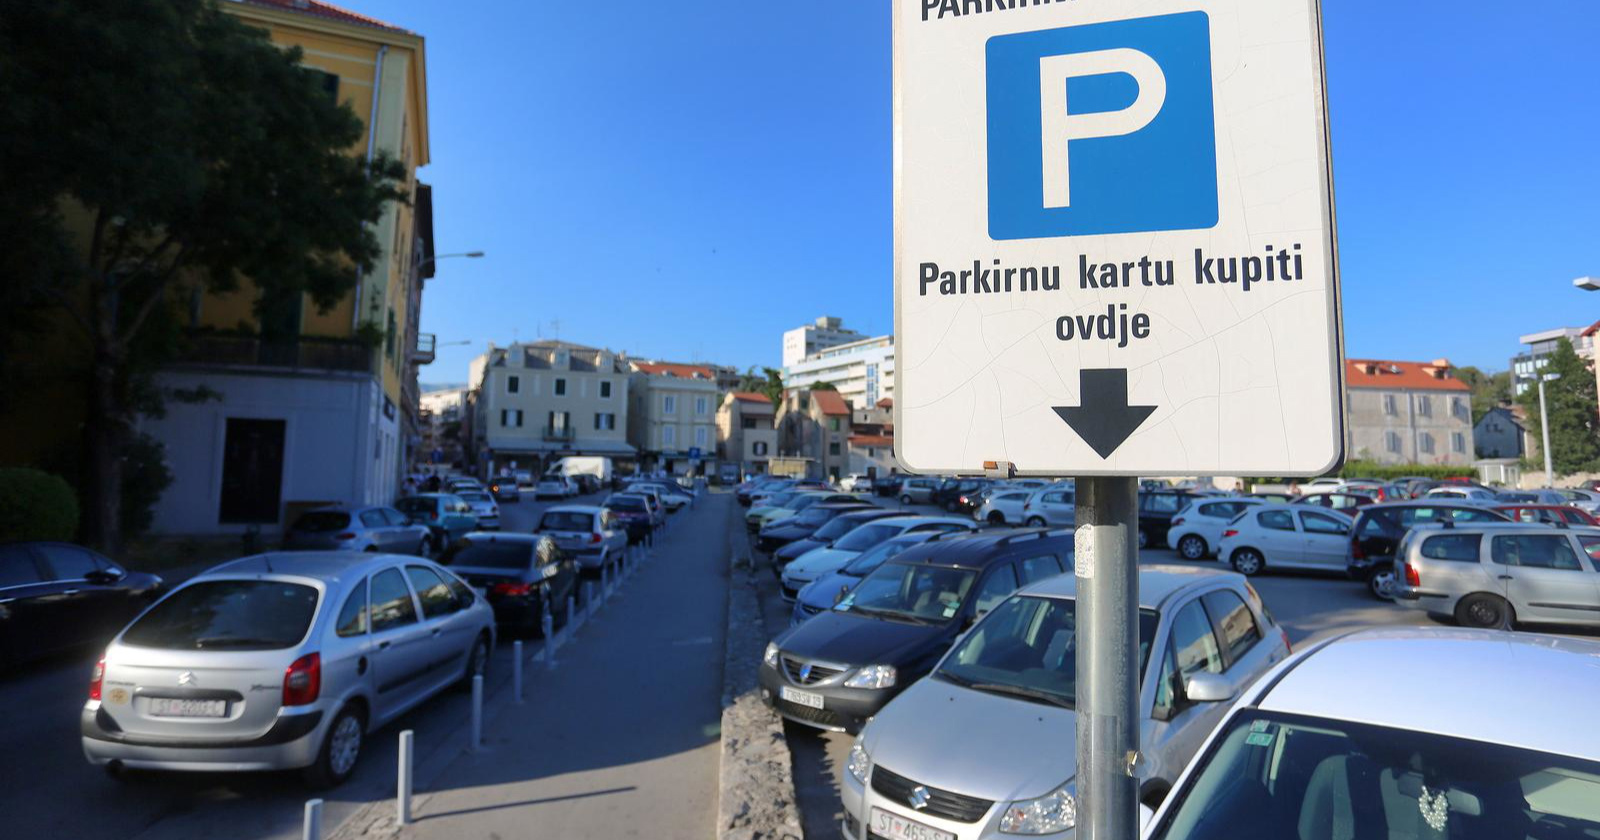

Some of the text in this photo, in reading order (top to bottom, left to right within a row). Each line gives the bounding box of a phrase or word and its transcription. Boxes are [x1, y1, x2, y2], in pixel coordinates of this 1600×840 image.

[1040, 48, 1167, 208] P
[920, 243, 1302, 296] Parkirnu kartu kupiti
[1056, 304, 1150, 347] ovdje
